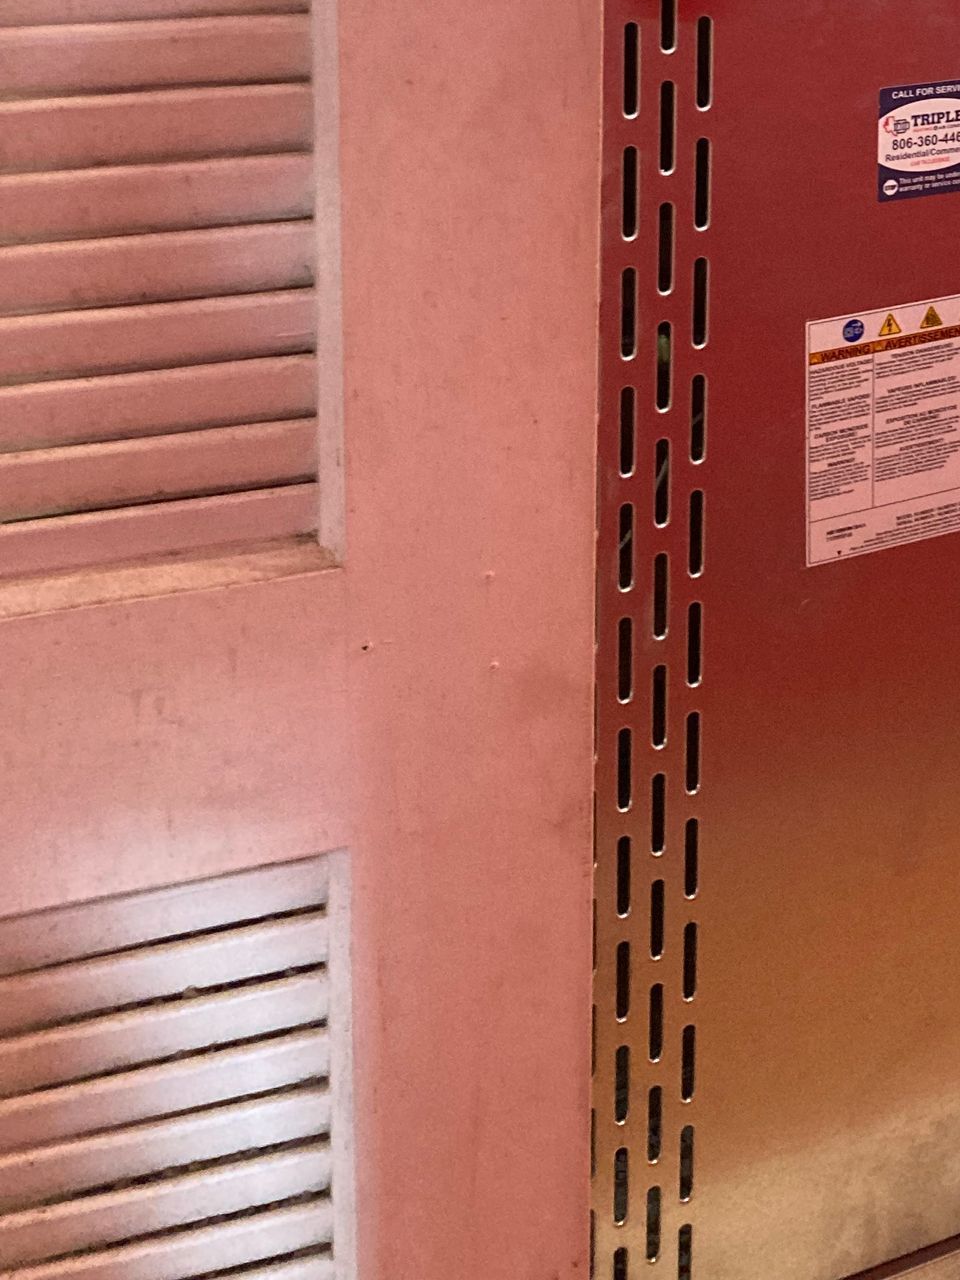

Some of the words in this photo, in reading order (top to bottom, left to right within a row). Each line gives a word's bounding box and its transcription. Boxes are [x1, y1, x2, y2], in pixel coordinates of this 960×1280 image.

[891, 90, 914, 99] CALL
[915, 87, 935, 97] FOR
[899, 177, 911, 185] This
[912, 175, 924, 183] unit
[924, 174, 936, 183] may
[937, 172, 945, 180] be
[945, 171, 960, 179] under
[820, 344, 870, 362] WARNING
